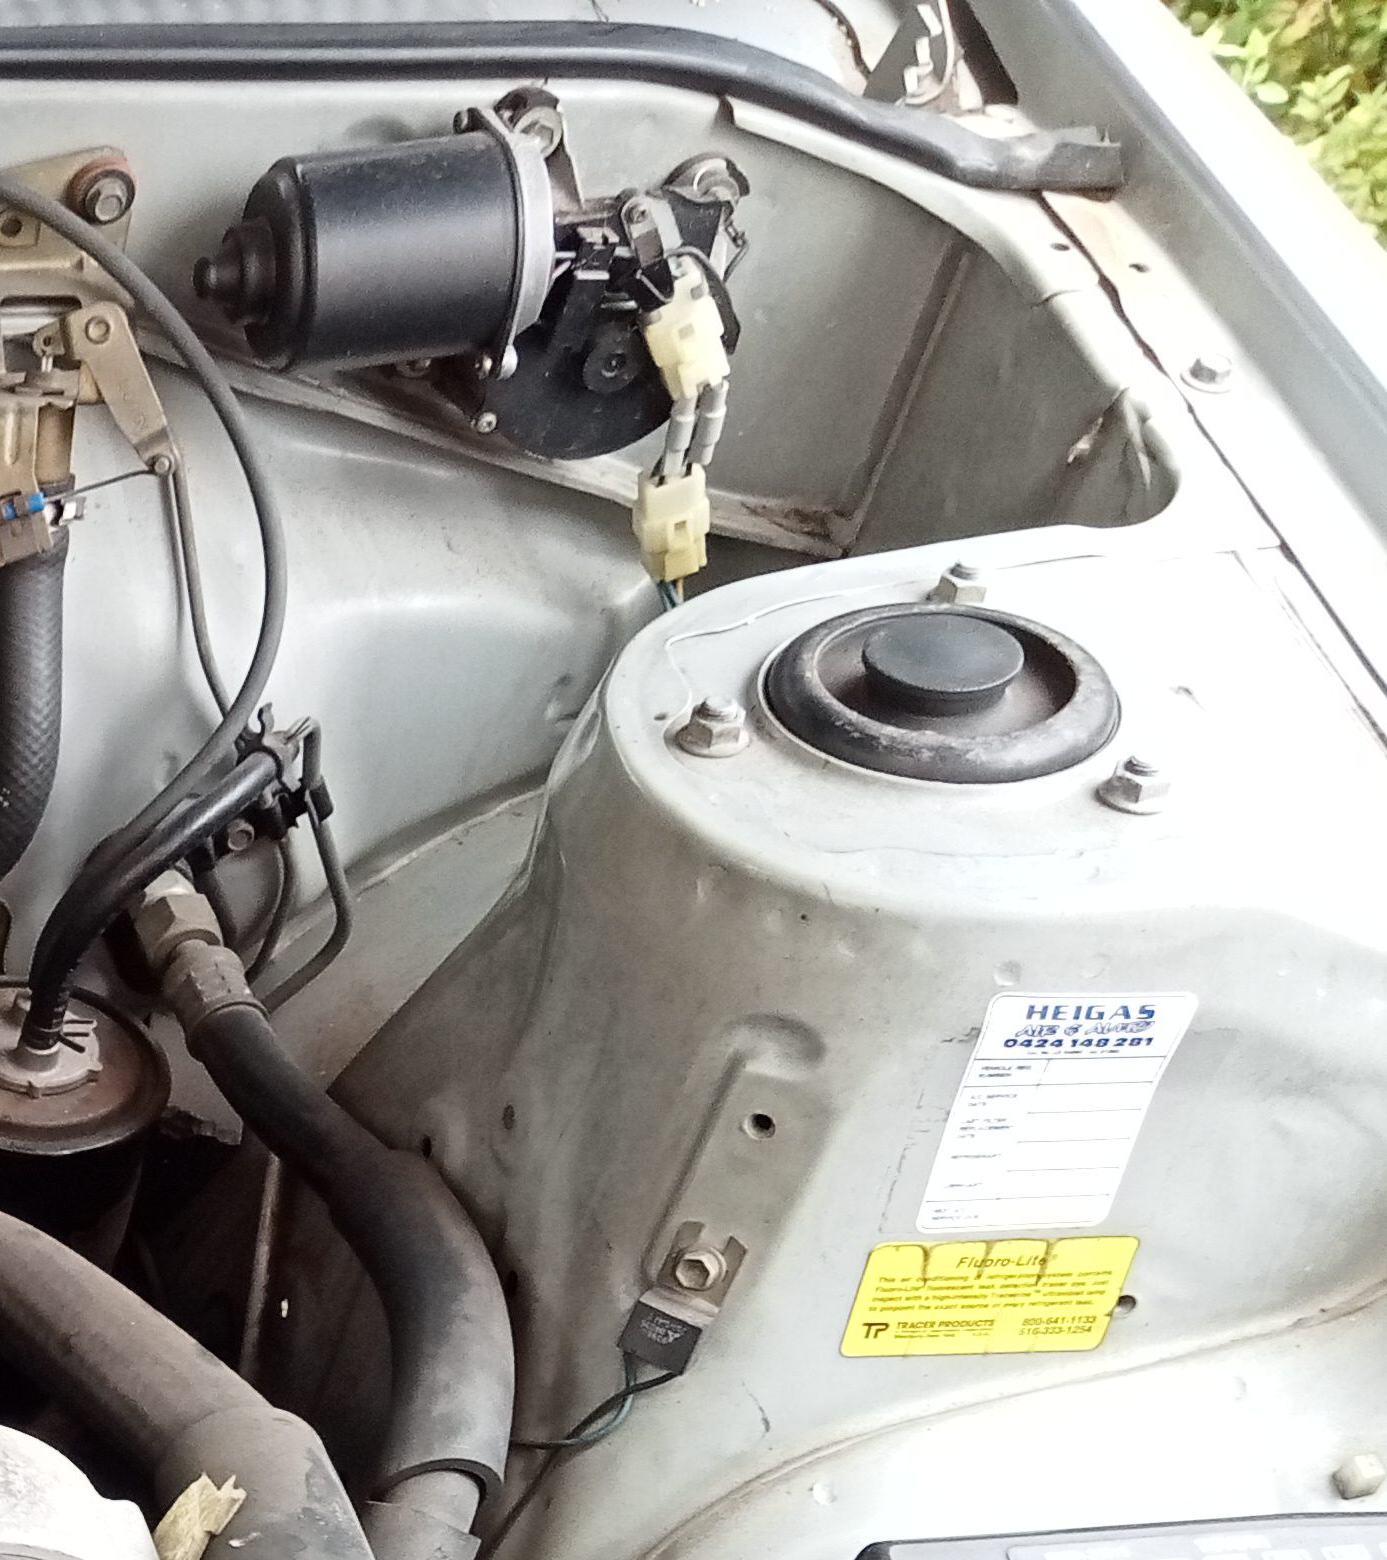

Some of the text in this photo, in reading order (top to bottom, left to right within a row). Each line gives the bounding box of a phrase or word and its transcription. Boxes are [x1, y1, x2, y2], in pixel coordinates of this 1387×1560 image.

[1026, 1004, 1156, 1021] HEIGAS
[1003, 1036, 1155, 1048] 0424 148 281
